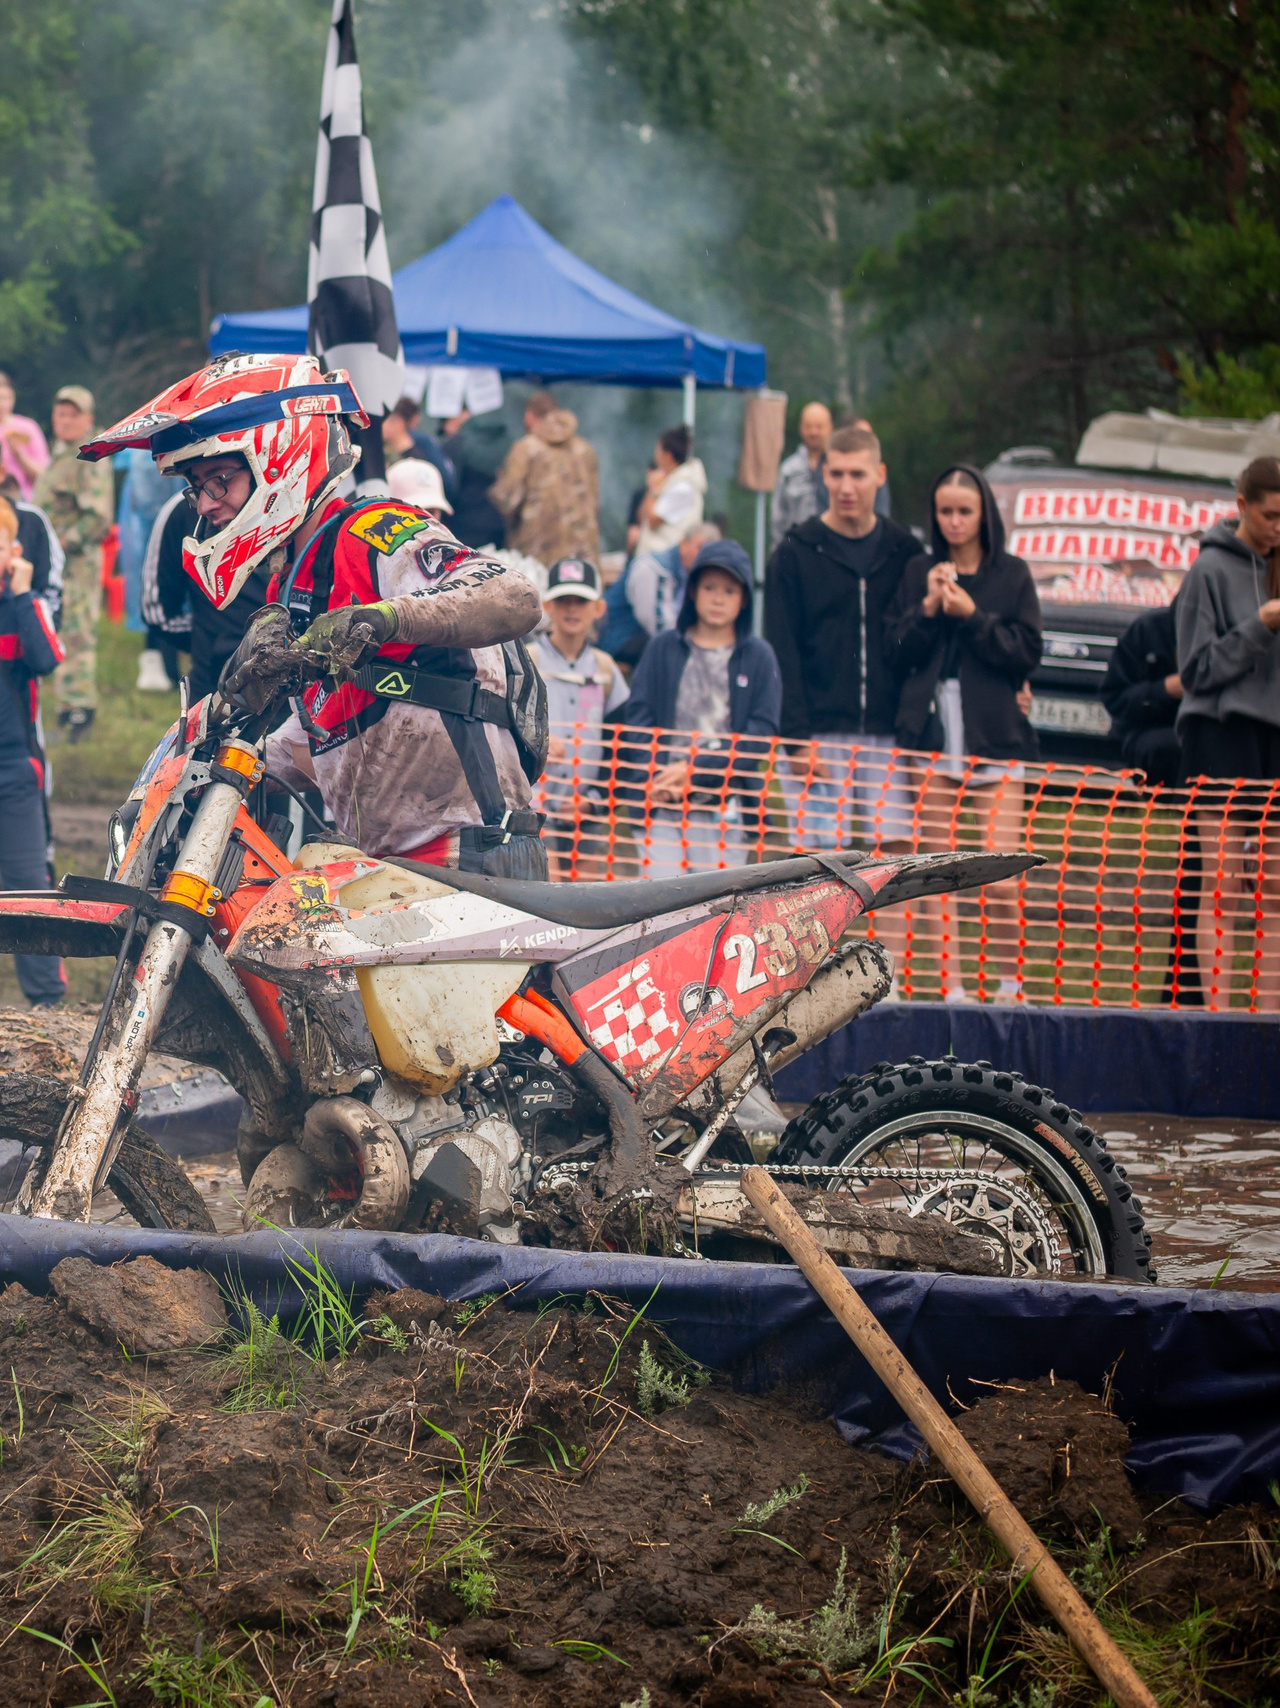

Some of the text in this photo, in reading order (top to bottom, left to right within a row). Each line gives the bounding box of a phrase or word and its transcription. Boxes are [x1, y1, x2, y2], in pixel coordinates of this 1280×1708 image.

[1016, 532, 1199, 564] ШАШЛЫ
[216, 575, 225, 597] AIROH
[524, 926, 578, 949] KENDA
[723, 908, 832, 995] 235
[522, 1093, 554, 1105] TPI
